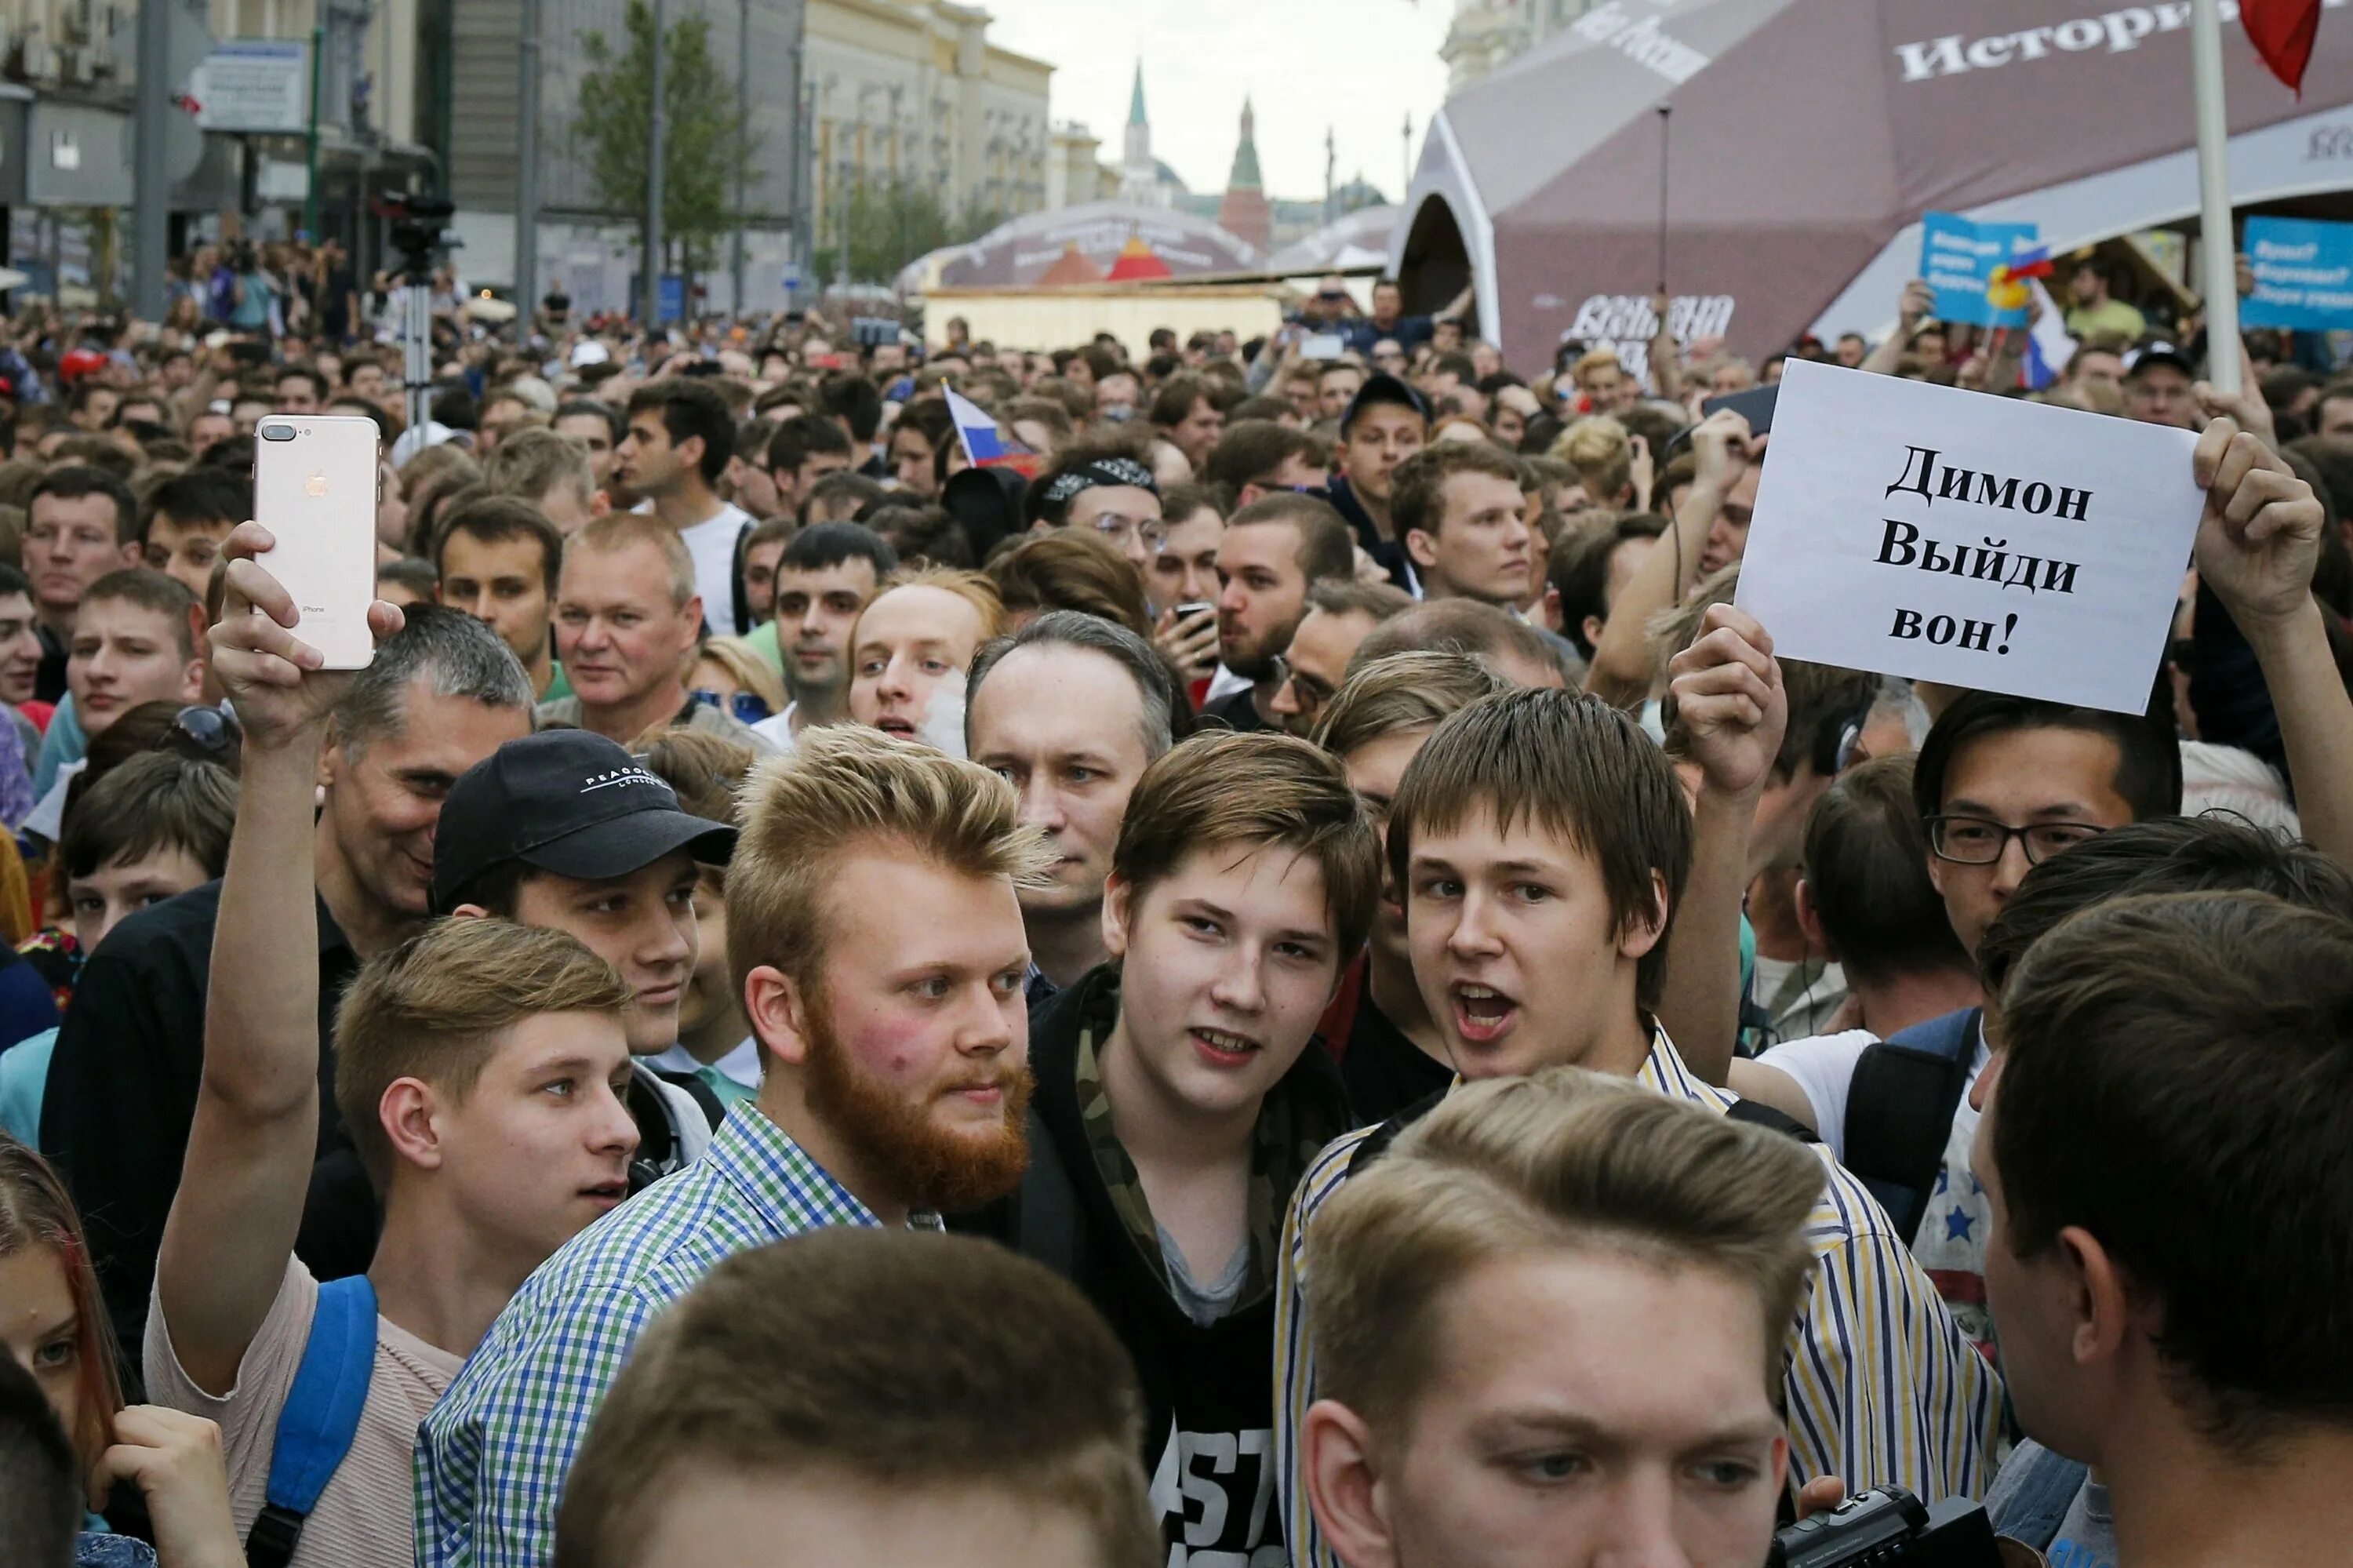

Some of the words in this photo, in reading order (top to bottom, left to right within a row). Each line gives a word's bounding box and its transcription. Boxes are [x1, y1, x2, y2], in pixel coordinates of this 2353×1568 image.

[1895, 0, 2241, 82] Истори
[1885, 445, 2094, 522] Димон
[1872, 518, 2081, 595] Выйди
[1888, 608, 2018, 655] вон!
